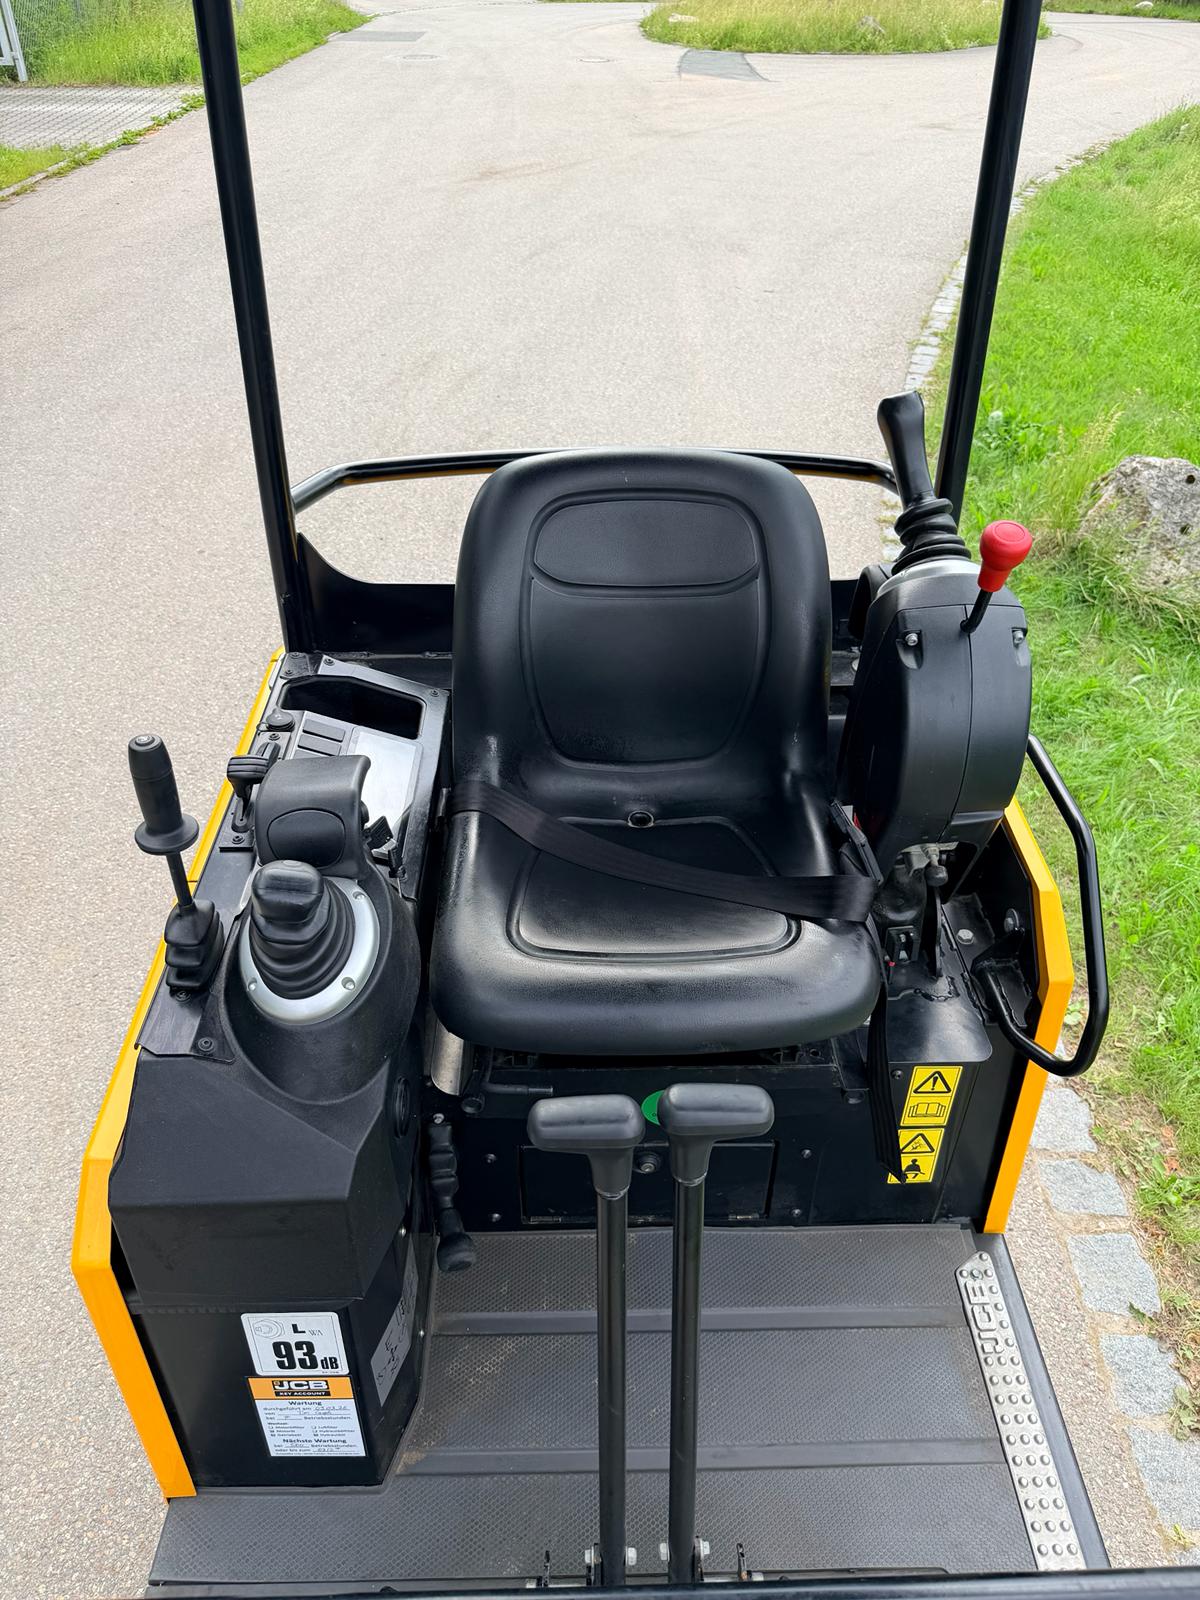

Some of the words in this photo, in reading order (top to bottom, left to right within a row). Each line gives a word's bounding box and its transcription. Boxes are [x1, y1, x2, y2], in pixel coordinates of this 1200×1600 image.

[291, 1323, 306, 1334] L
[271, 1340, 319, 1370] 93
[320, 1356, 340, 1370] dB
[273, 1380, 328, 1390] JCB
